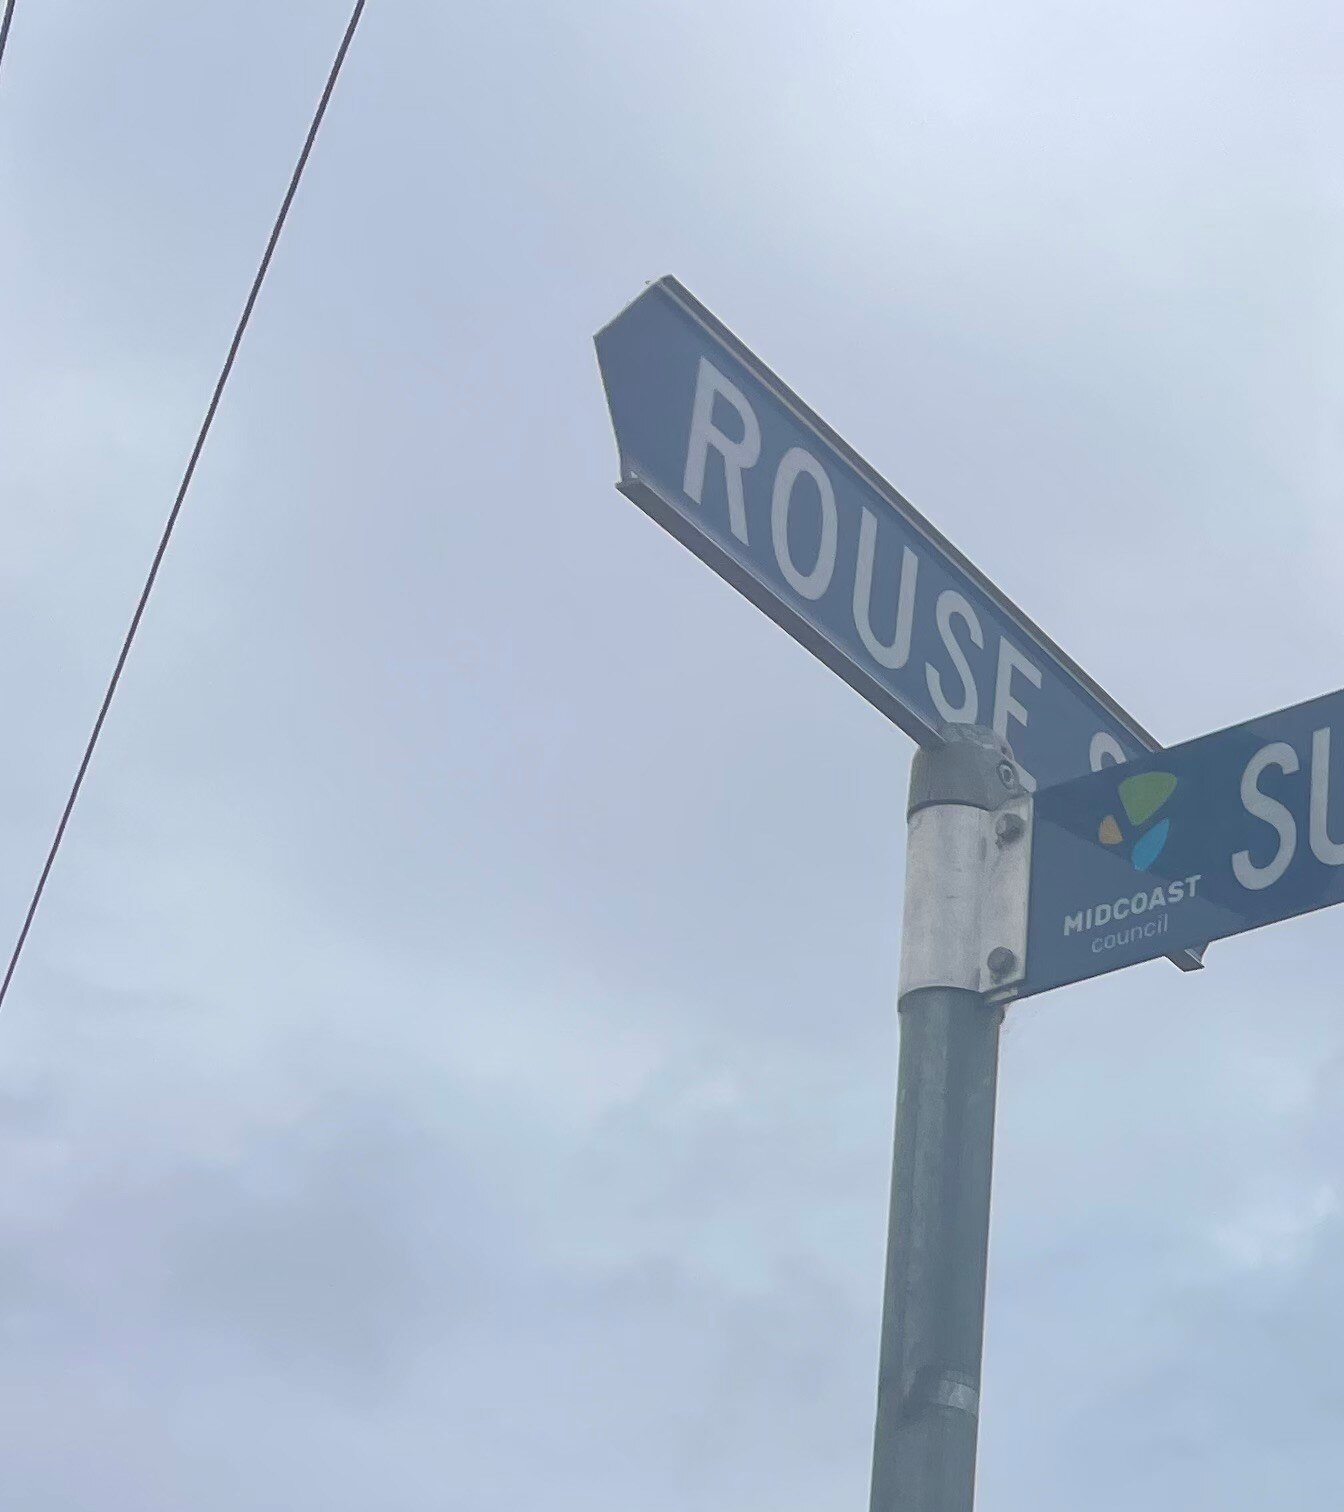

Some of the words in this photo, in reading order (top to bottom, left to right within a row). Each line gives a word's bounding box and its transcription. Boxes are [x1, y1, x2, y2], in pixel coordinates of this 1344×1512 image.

[683, 356, 1042, 793] ROUSE
[1063, 875, 1202, 936] MIDCOAST
[1091, 913, 1169, 953] council
